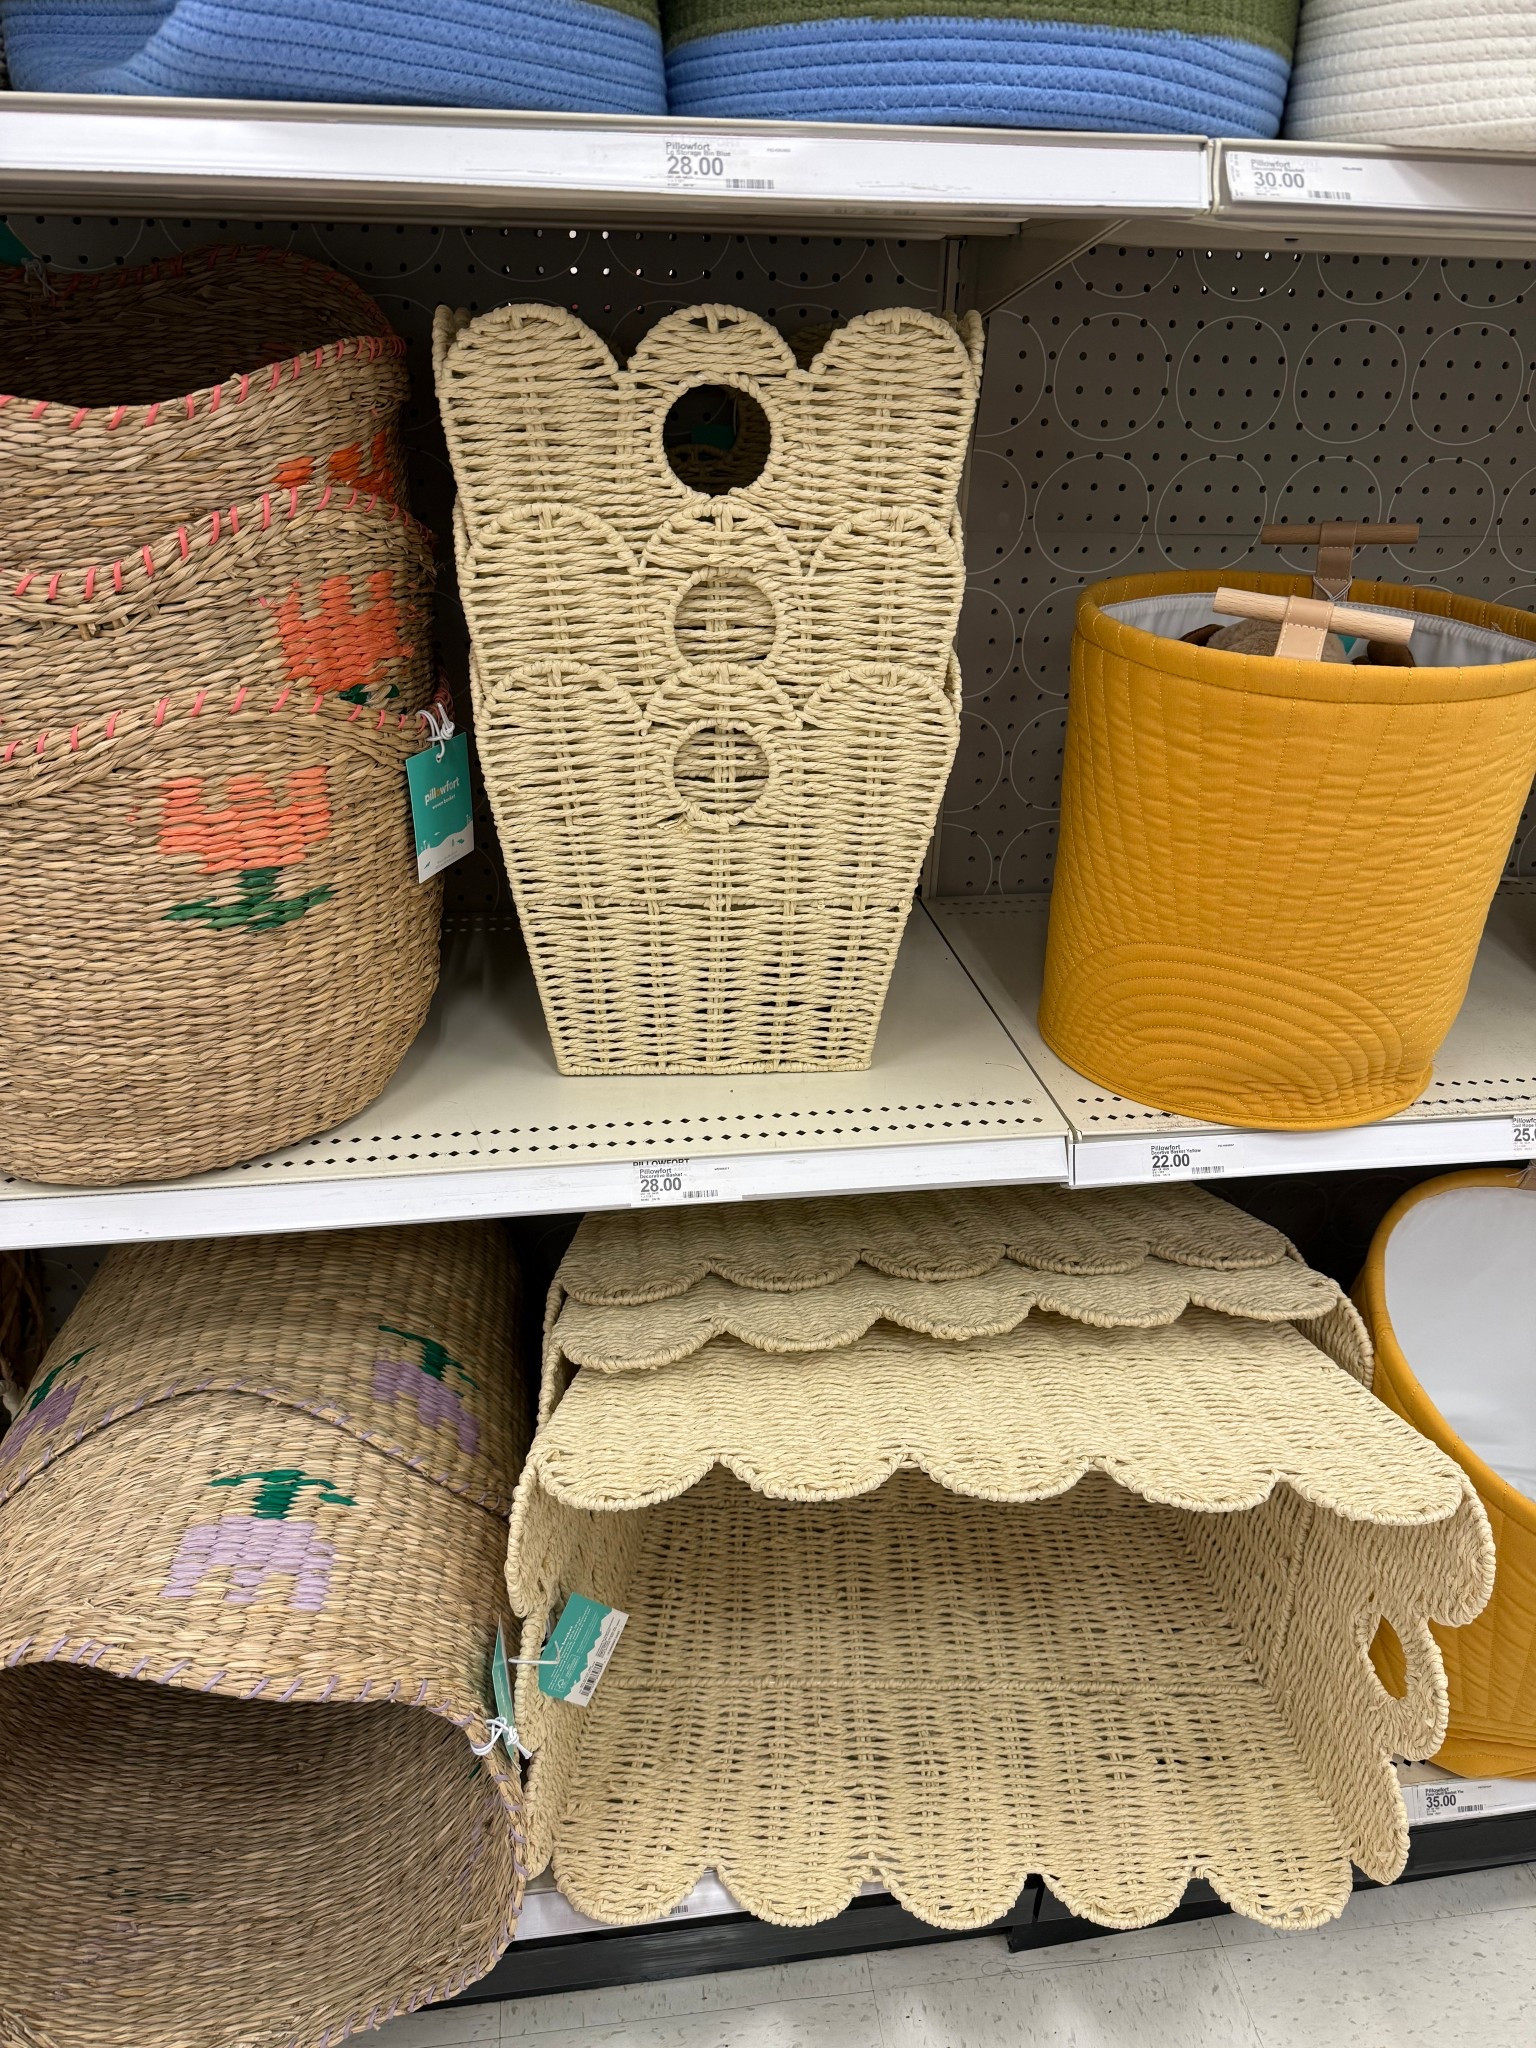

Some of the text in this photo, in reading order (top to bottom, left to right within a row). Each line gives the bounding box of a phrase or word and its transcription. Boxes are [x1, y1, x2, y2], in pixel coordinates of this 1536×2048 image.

[666, 141, 710, 151] Pillowfort
[667, 156, 724, 176] 28.00
[1251, 158, 1291, 169] Pillowfort
[1254, 171, 1305, 189] 30.00
[424, 776, 460, 806] pillowfort
[1513, 1128, 1536, 1142] 25.
[1151, 1144, 1181, 1152] Pillowfort
[1152, 1154, 1190, 1168] 22.00
[640, 1167, 672, 1175] Pillowfort
[640, 1177, 682, 1193] 28.00
[1426, 1794, 1456, 1809] 35.00
